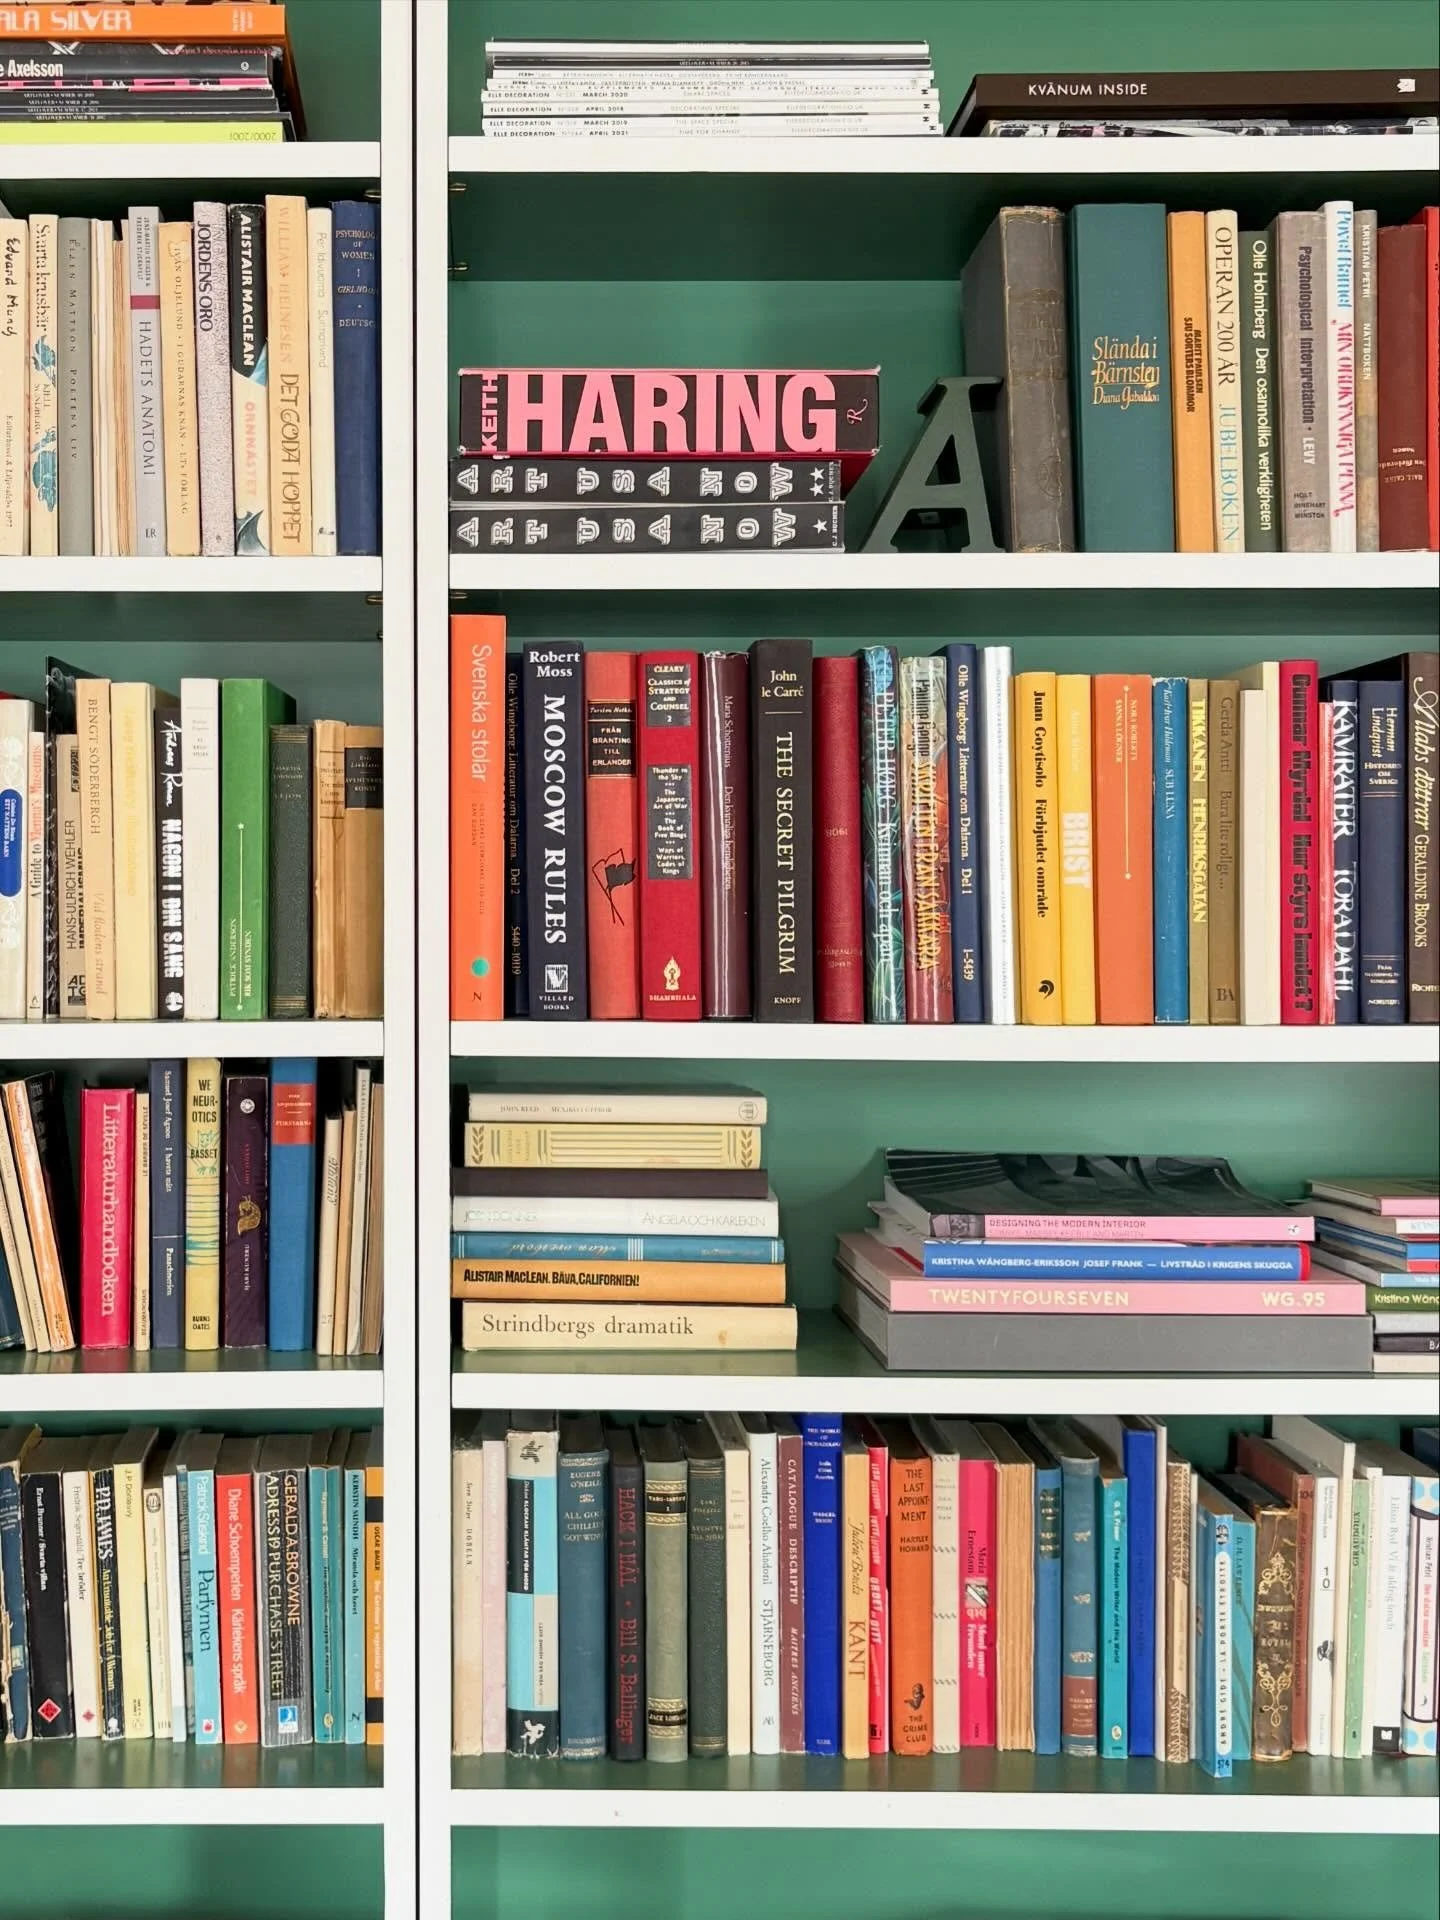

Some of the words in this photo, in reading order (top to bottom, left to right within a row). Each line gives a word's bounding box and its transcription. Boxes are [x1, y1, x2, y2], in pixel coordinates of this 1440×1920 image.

[50, 10, 132, 31] SILVER
[8, 60, 64, 78] Axelsson
[1028, 81, 1093, 96] KVÄNUM
[1098, 83, 1148, 95] INSIDE
[4, 238, 20, 286] Edvard
[34, 224, 51, 269] Svarta
[197, 221, 212, 293] JORDENS
[240, 213, 253, 287] ALISTAIR
[277, 207, 290, 277] WILLIAM
[1252, 240, 1267, 269] Olle
[1361, 224, 1370, 269] KRISTIAN
[1215, 226, 1234, 314] OPERAN
[1298, 246, 1313, 331] Psychological
[1362, 271, 1371, 298] PETRI
[2, 295, 18, 337] Munch
[35, 272, 51, 332] krusbär
[199, 295, 213, 332] ORO
[278, 283, 292, 362] HEINESEN
[1252, 272, 1267, 339] Holmberg
[242, 289, 255, 366] MACLEAN
[1092, 335, 1149, 360] Slända
[1153, 336, 1157, 359] i
[1217, 320, 1235, 353] 200
[138, 320, 154, 387] HADETS
[1218, 357, 1236, 387] ÅR
[1256, 347, 1269, 373] Den
[1363, 323, 1371, 381] NATTBOKEN
[280, 374, 299, 406] DET
[1301, 337, 1315, 424] Interpretation
[141, 395, 156, 475] ANATOMI
[482, 375, 499, 452] KEITH
[506, 373, 837, 453] HARING
[1256, 378, 1270, 448] osannolika
[281, 408, 301, 464] GODA
[1302, 437, 1315, 465] LEVY
[457, 464, 548, 494] ART
[576, 466, 671, 494] USA
[700, 462, 794, 500] NOW
[1219, 403, 1240, 542] JUBELBOKEN
[1258, 451, 1272, 531] verkligheten
[282, 472, 302, 542] HOPPET
[457, 516, 548, 546] ART
[576, 516, 671, 545] USA
[700, 508, 797, 547] NOW
[529, 650, 581, 663] Robert
[537, 667, 573, 678] Moss
[770, 670, 797, 681] John
[470, 644, 492, 723] Svenska
[648, 687, 690, 695] STRATEGY
[761, 686, 773, 697] le
[774, 686, 804, 697] Carré
[1033, 690, 1046, 722] Juan
[88, 699, 98, 744] BENGT
[650, 702, 689, 711] COUNSEL
[876, 692, 895, 751] PETER
[1385, 707, 1398, 751] Herman
[1413, 677, 1440, 762] Allahs
[162, 719, 182, 767] Andreas
[1192, 699, 1205, 782] TIKKANEN
[1370, 707, 1384, 757] Lindqvist
[471, 729, 491, 782] stolar
[543, 694, 566, 836] MOSCOW
[776, 732, 793, 778] THE
[1032, 726, 1047, 788] Goytisolo
[1333, 699, 1358, 841] KAMRATER
[89, 747, 101, 835] SÖDERBERGH
[162, 771, 181, 807] Roman
[878, 759, 897, 808] HØEG
[1413, 768, 1435, 830] döttrar
[65, 820, 77, 871] WEHLER
[162, 819, 182, 878] NÅGON
[776, 787, 794, 870] SECRET
[1035, 799, 1048, 864] Förbjudet
[1063, 812, 1090, 889] BRIST
[877, 823, 897, 886] Kvinnan
[1192, 799, 1206, 923] HENRIKSGATAN
[1414, 834, 1429, 901] GERALDINE
[65, 878, 77, 950] HANS-ULRICH
[93, 892, 104, 913] Vid
[162, 897, 182, 927] DIN
[545, 848, 567, 944] RULES
[879, 890, 897, 918] och
[1036, 867, 1049, 918] område
[1334, 861, 1357, 925] TORA
[93, 916, 105, 956] flodens
[778, 880, 795, 975] PILGRIM
[879, 923, 894, 963] apan
[1414, 902, 1429, 947] BROOKS
[95, 958, 107, 995] strand
[164, 932, 183, 978] SÄNG
[1334, 932, 1357, 1000] DAHL
[193, 1095, 218, 1107] NEUR-
[198, 1080, 211, 1091] WE
[192, 1112, 217, 1122] OTICS
[190, 1149, 218, 1158] BASSET
[102, 1103, 120, 1316] Litteraturhandboken
[989, 1219, 1041, 1228] DESIGNING
[1043, 1220, 1061, 1228] THE
[1062, 1220, 1101, 1229] MODERN
[1103, 1221, 1146, 1230] INTERIOR
[932, 1257, 975, 1265] KRISTINA
[1083, 1259, 1109, 1268] JOSEF
[1111, 1259, 1144, 1269] FRANK
[1254, 1262, 1293, 1270] SKUGGA
[929, 1289, 1129, 1305] TWENTYFOURSEVEN
[482, 1314, 595, 1339] Strindbergs
[604, 1315, 693, 1335] dramatik
[196, 1476, 209, 1513] Patrick
[904, 1484, 924, 1492] LAST
[906, 1469, 923, 1477] THE
[228, 1489, 241, 1521] Diane
[265, 1474, 281, 1535] ADRESS
[618, 1488, 636, 1534] HACK
[898, 1497, 929, 1506] APPOINT-
[900, 1512, 926, 1521] MENT
[197, 1513, 209, 1555] Süskind
[267, 1536, 281, 1548] 19
[848, 1518, 865, 1558] Julien
[967, 1529, 976, 1574] Ernestam
[229, 1523, 243, 1600] Schoemperlen
[619, 1553, 638, 1587] HÄL
[851, 1558, 864, 1595] Benda
[978, 1547, 986, 1574] Maria
[195, 1569, 214, 1652] Parfymen
[268, 1552, 283, 1639] PURCHASE
[231, 1608, 244, 1661] Kärlekens
[620, 1618, 636, 1648] Bill
[848, 1620, 866, 1680] KANT
[967, 1624, 975, 1669] Freunden
[978, 1624, 987, 1650] Mord
[231, 1663, 245, 1694] språk
[270, 1641, 284, 1700] STREET
[620, 1654, 637, 1667] S.
[978, 1651, 986, 1677] unter
[616, 1672, 638, 1744] Ballinger
